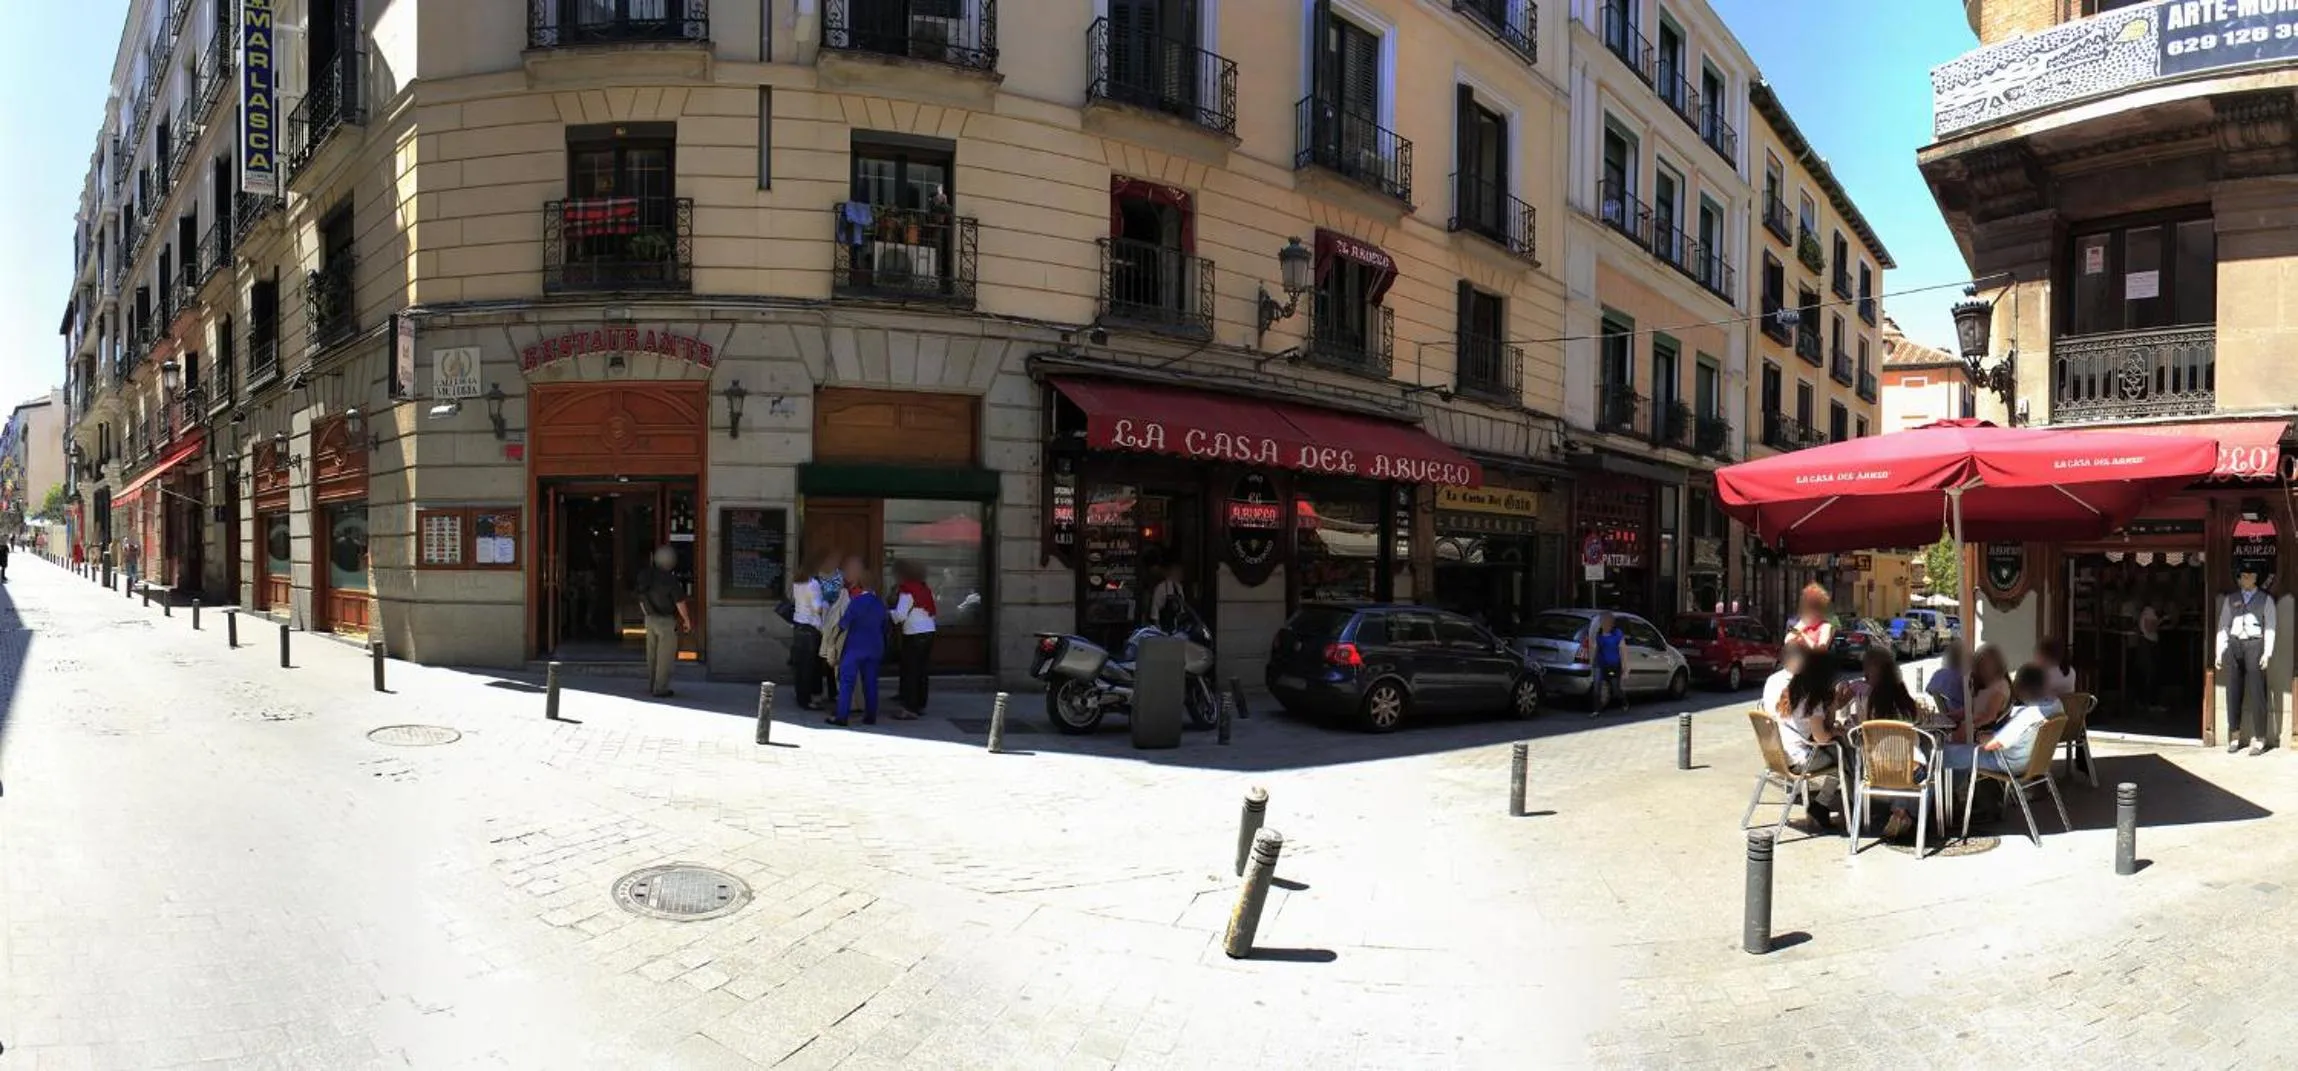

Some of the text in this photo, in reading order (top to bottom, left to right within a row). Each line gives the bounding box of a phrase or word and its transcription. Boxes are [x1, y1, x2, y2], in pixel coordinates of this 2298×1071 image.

[2167, 34, 2218, 56] 629
[2223, 26, 2269, 46] 126
[244, 11, 270, 170] MARLASCA
[1351, 246, 1389, 267] ABUELO
[523, 328, 713, 371] RESTAURANTE
[1112, 419, 1471, 486] LA CASA DEL ABUELO
[2053, 460, 2066, 469] LA
[1796, 475, 1808, 484] LA
[1809, 474, 1834, 483] CASA
[1837, 471, 1855, 480] DEL
